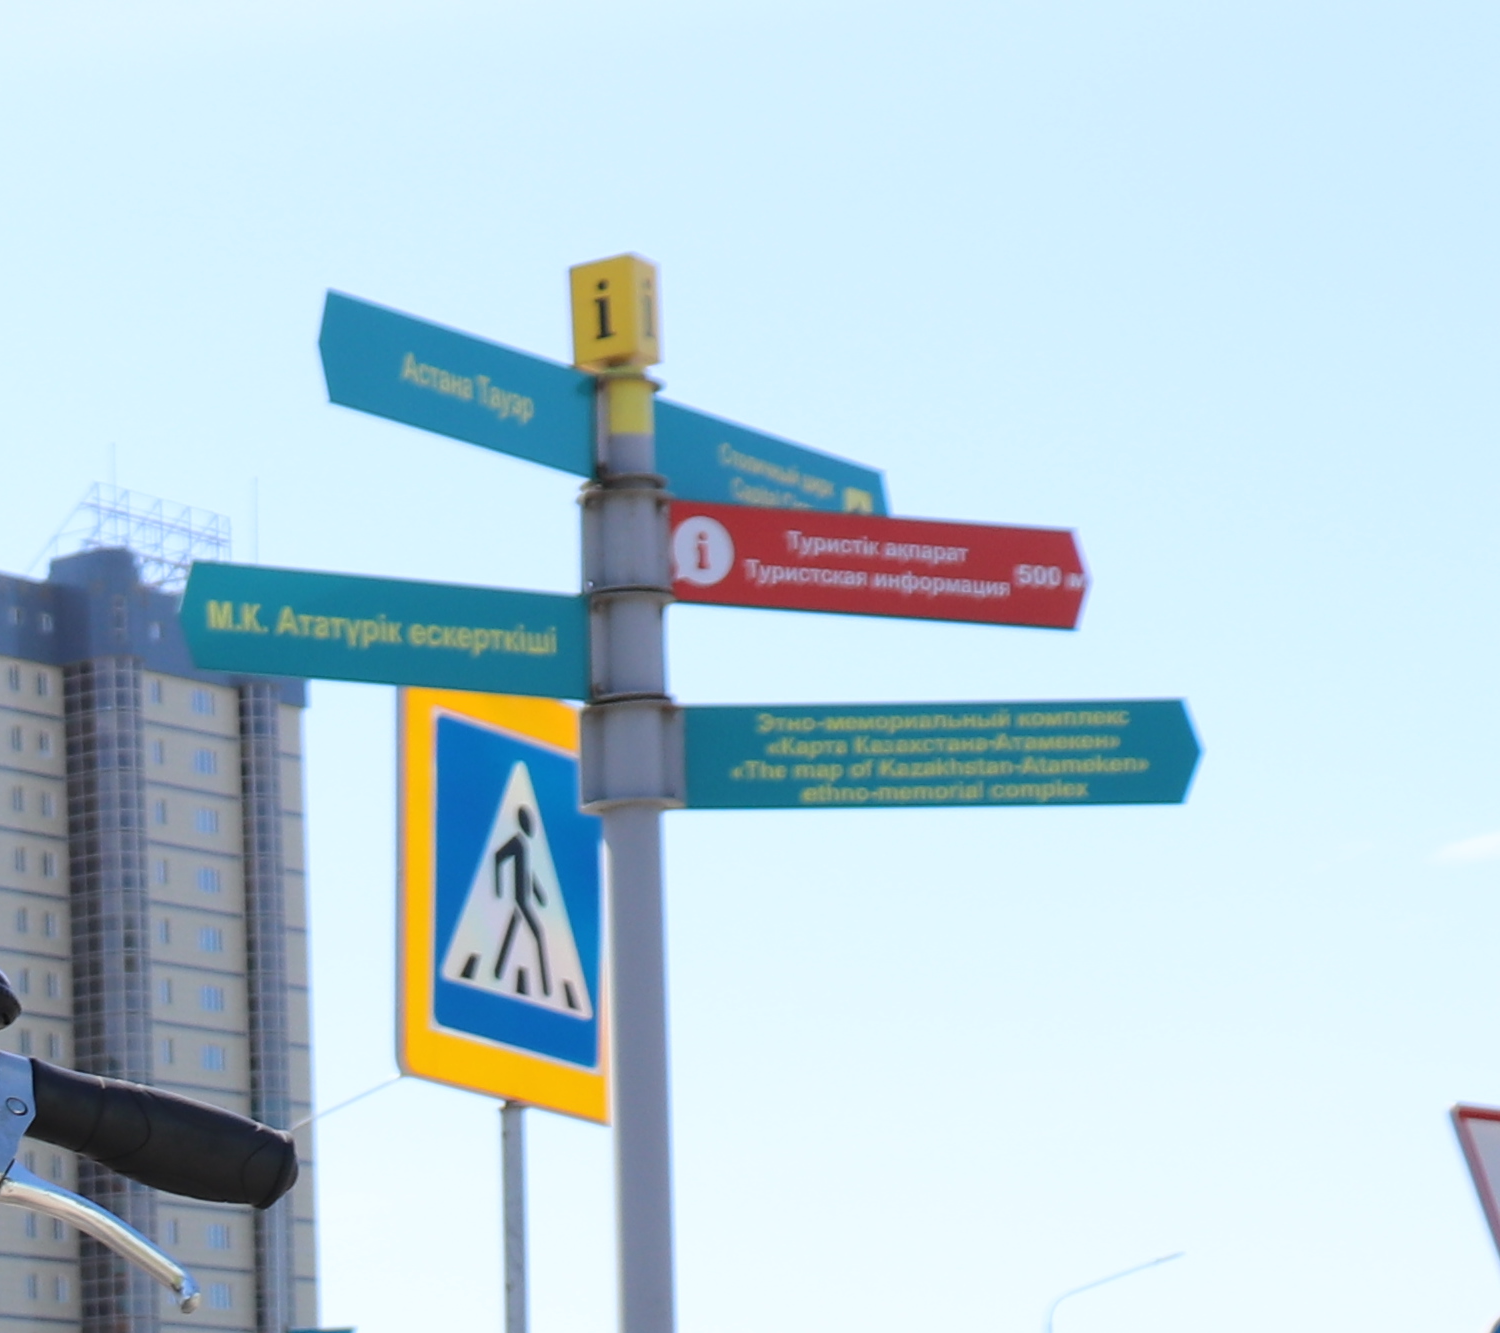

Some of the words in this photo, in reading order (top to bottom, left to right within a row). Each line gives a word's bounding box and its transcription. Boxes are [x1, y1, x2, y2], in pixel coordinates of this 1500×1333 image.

[401, 352, 474, 400] Астана
[477, 375, 534, 425] Тауэр
[787, 530, 879, 557] Туристік
[745, 560, 867, 588] Туристская
[874, 571, 1010, 597] информация
[1015, 565, 1061, 587] 500
[206, 600, 269, 634] М.К.
[276, 605, 403, 650] Ататүрік
[409, 623, 559, 657] ескерткіші
[1018, 708, 1131, 729] комплекс
[793, 764, 846, 784] map
[851, 758, 876, 779] of
[803, 780, 984, 802] ethno-memorial
[990, 778, 1090, 801] complex
